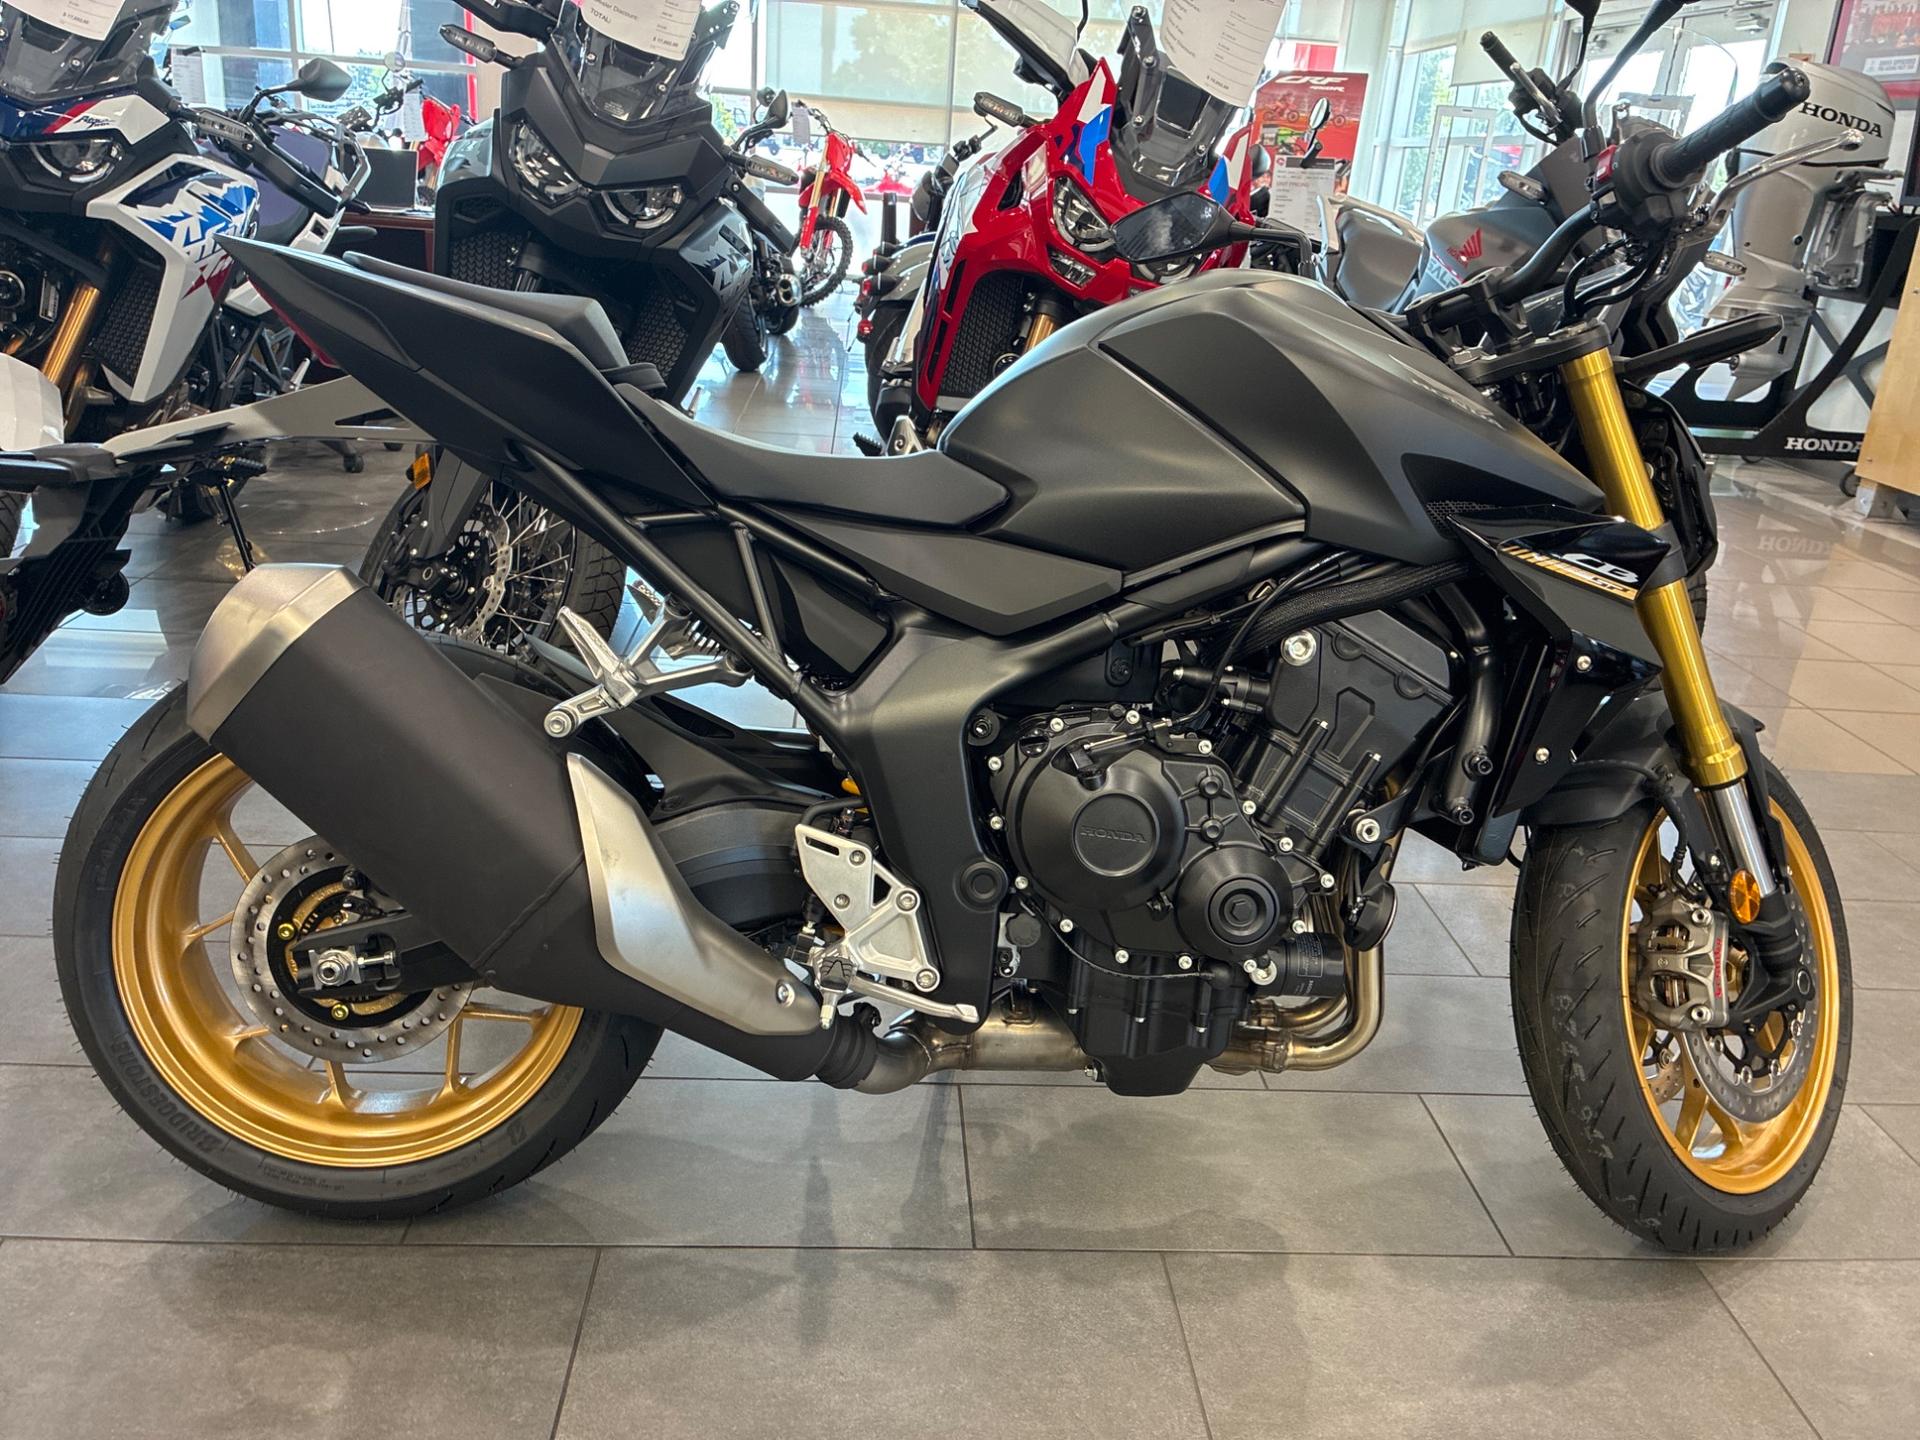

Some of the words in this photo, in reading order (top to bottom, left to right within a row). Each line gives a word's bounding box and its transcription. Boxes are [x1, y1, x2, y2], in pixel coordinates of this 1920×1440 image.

[1275, 75, 1349, 86] CRF
[1800, 101, 1883, 138] HONDA
[1551, 553, 1639, 583] CB
[1080, 825, 1147, 843] HONDA
[110, 1035, 224, 1152] BRIDGESTONE
